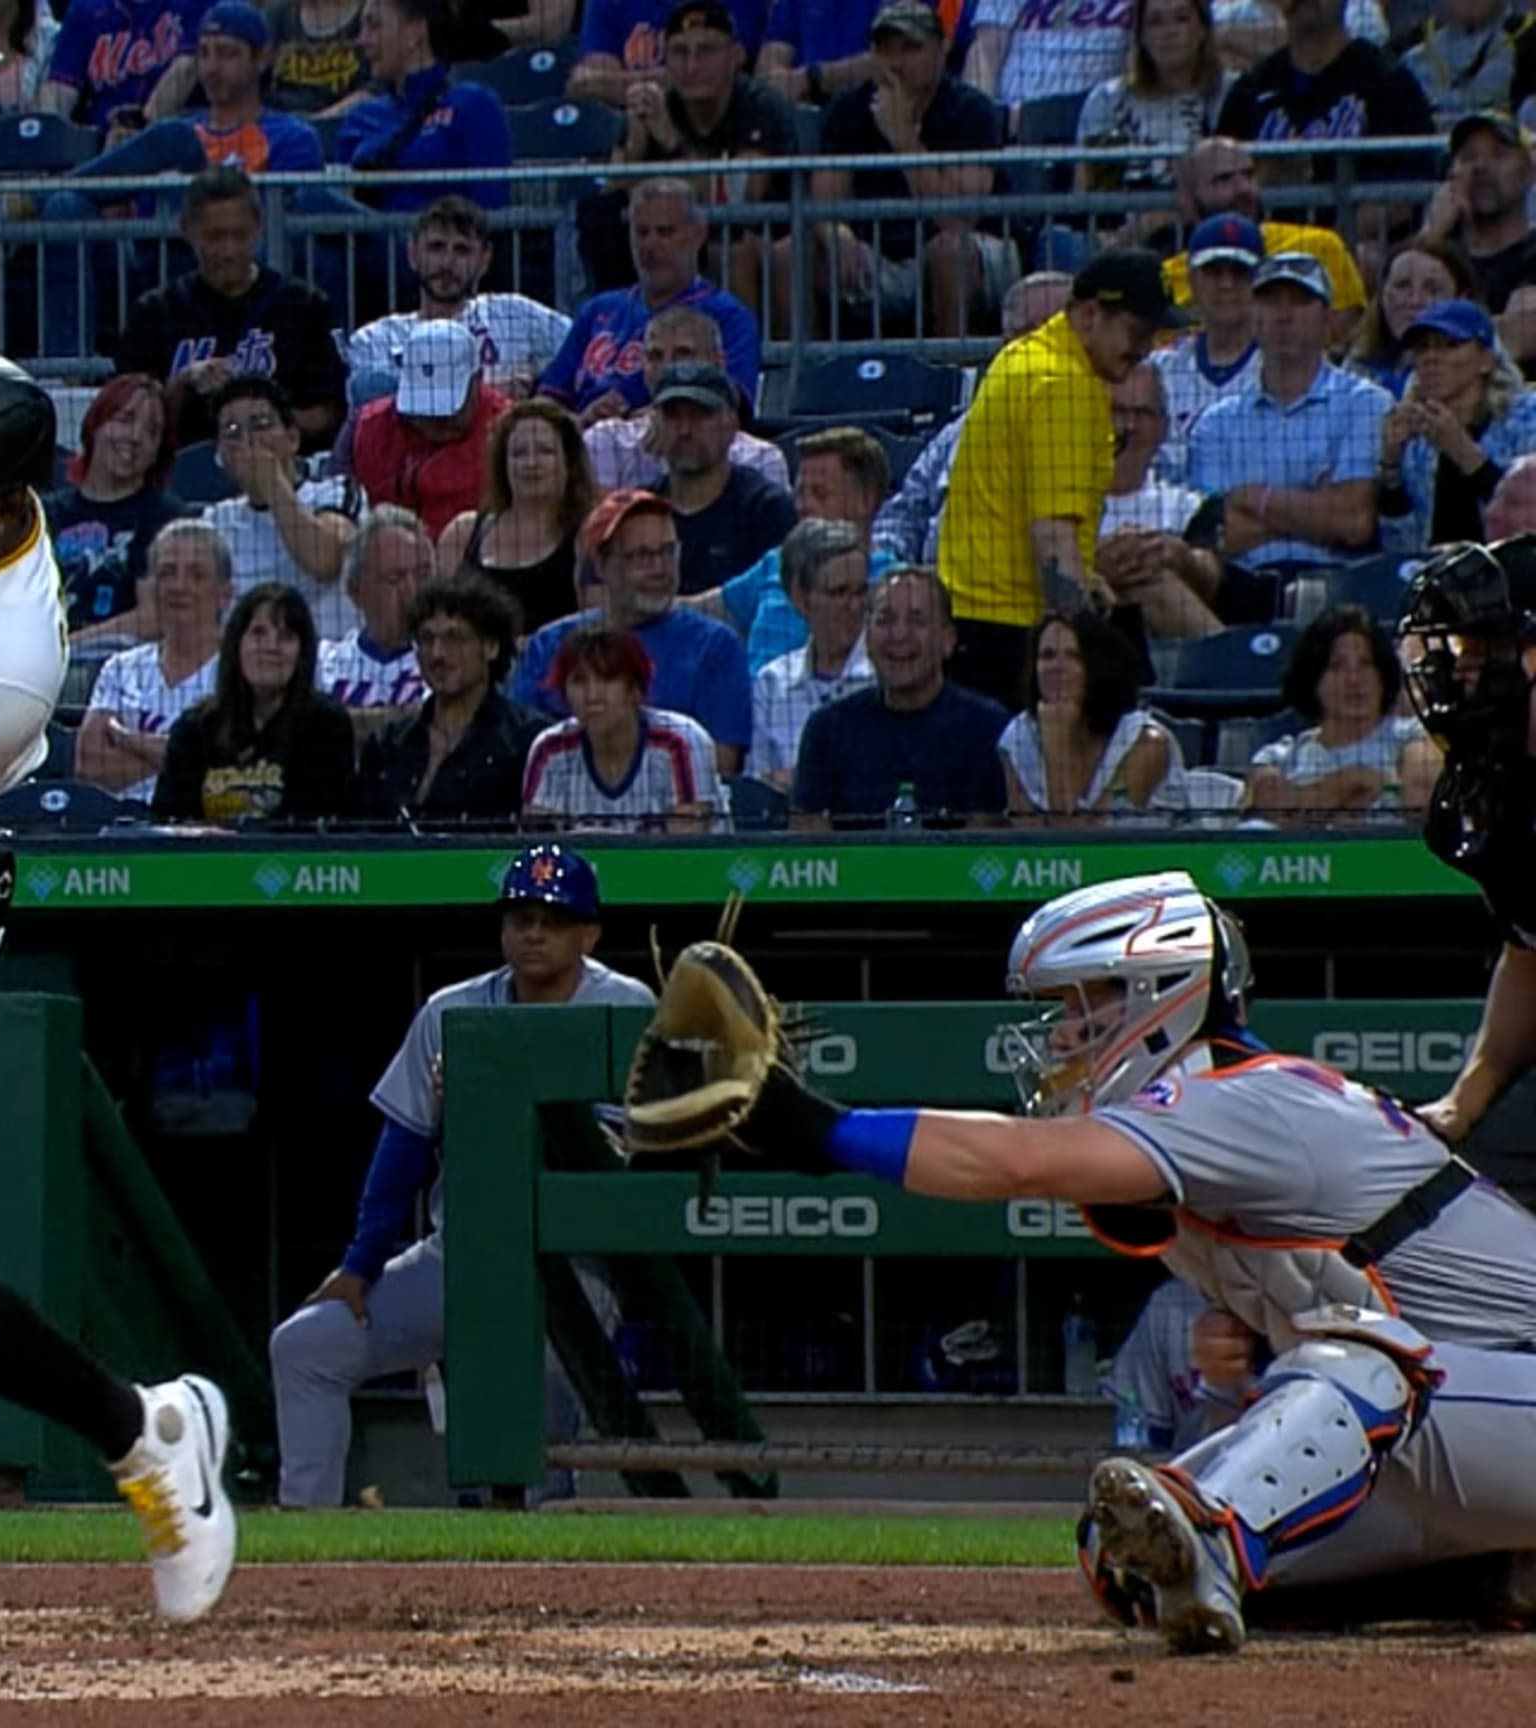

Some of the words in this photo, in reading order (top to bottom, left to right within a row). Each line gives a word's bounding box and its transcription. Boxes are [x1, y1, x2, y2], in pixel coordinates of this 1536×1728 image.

[63, 866, 131, 896] AHN
[293, 865, 361, 894] AHN
[768, 859, 840, 888] AHN
[1010, 858, 1083, 887] AHN
[1258, 855, 1332, 885] AHN
[1312, 1031, 1476, 1073] GEIC
[685, 1196, 879, 1237] GEICO
